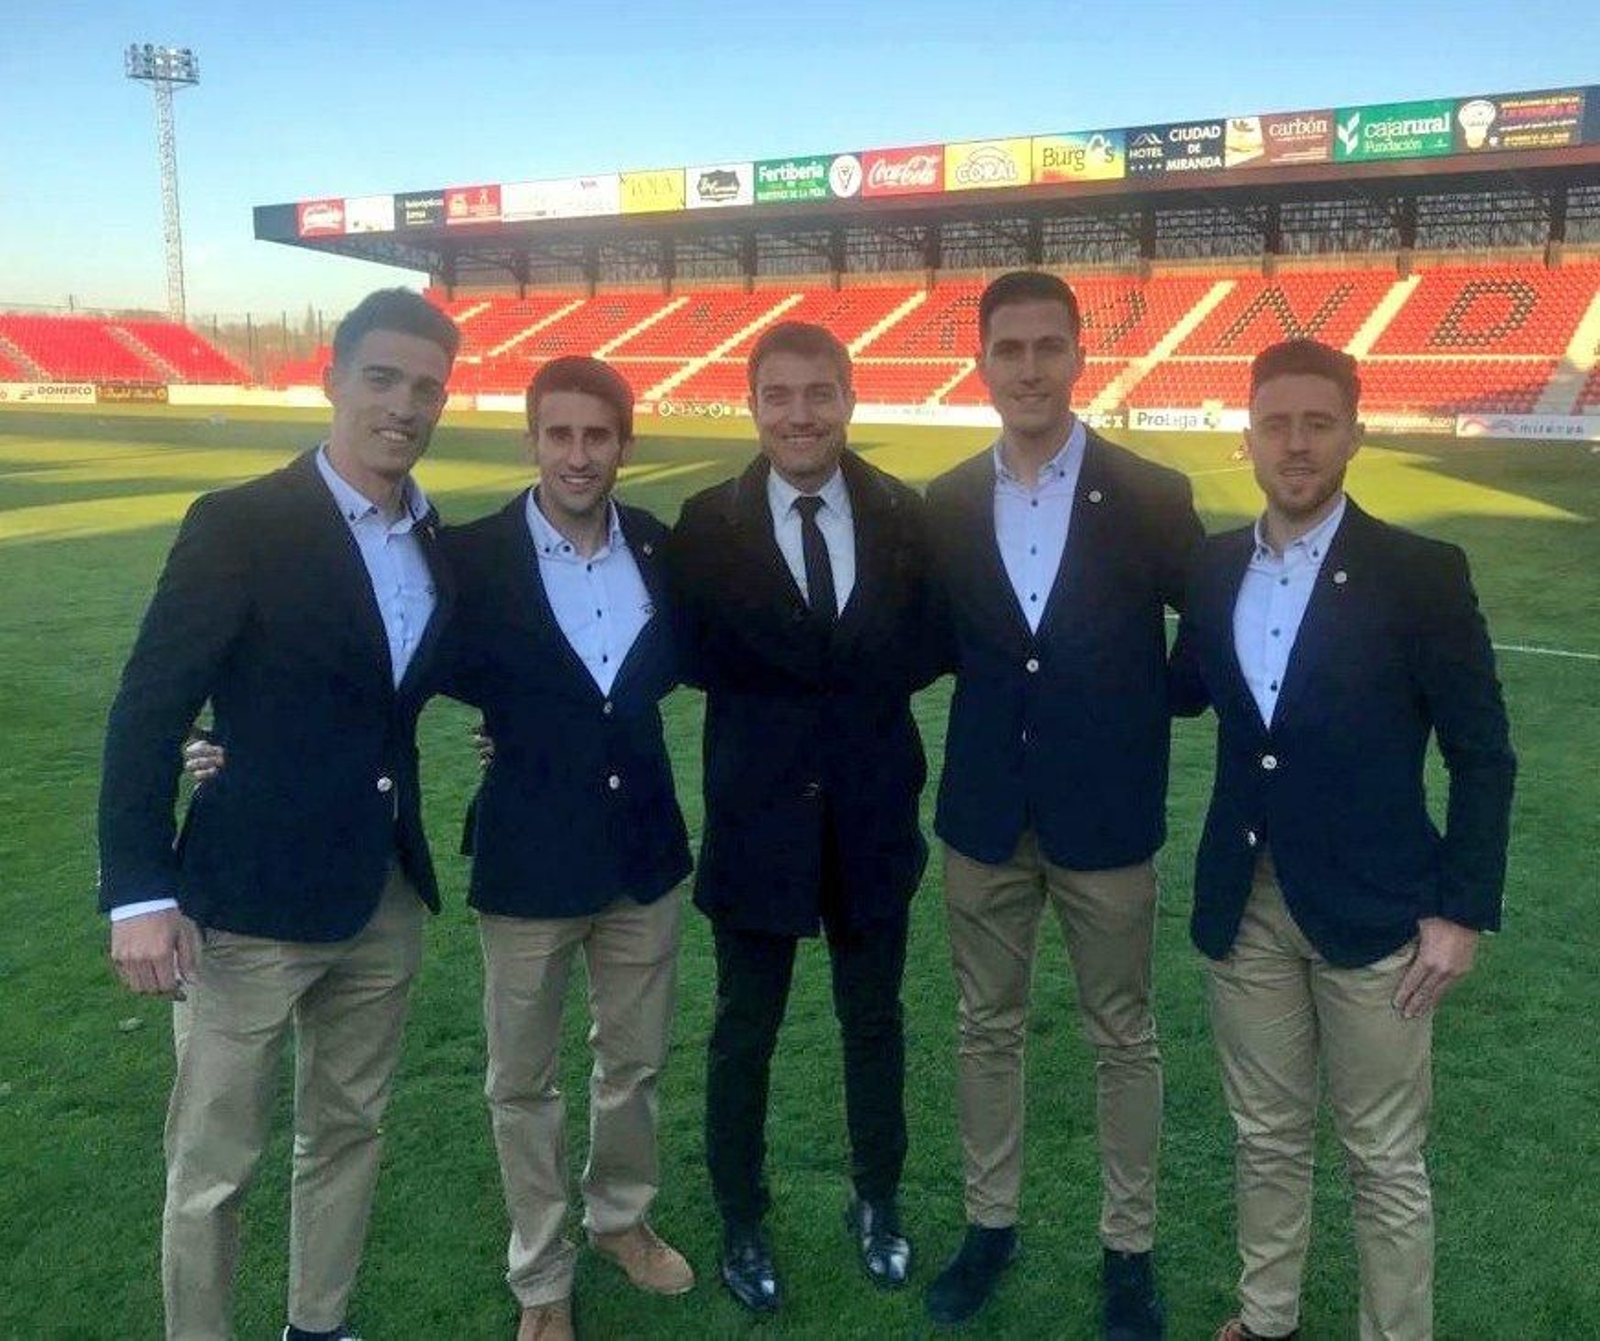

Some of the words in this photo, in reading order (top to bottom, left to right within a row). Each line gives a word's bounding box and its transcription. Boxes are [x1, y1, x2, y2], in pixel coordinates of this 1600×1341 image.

[1168, 125, 1221, 143] CIUDAD
[1129, 148, 1164, 159] HOTEL
[1187, 143, 1202, 155] DE
[1166, 155, 1223, 171] MIRANDA
[758, 160, 825, 183] Fertiberia
